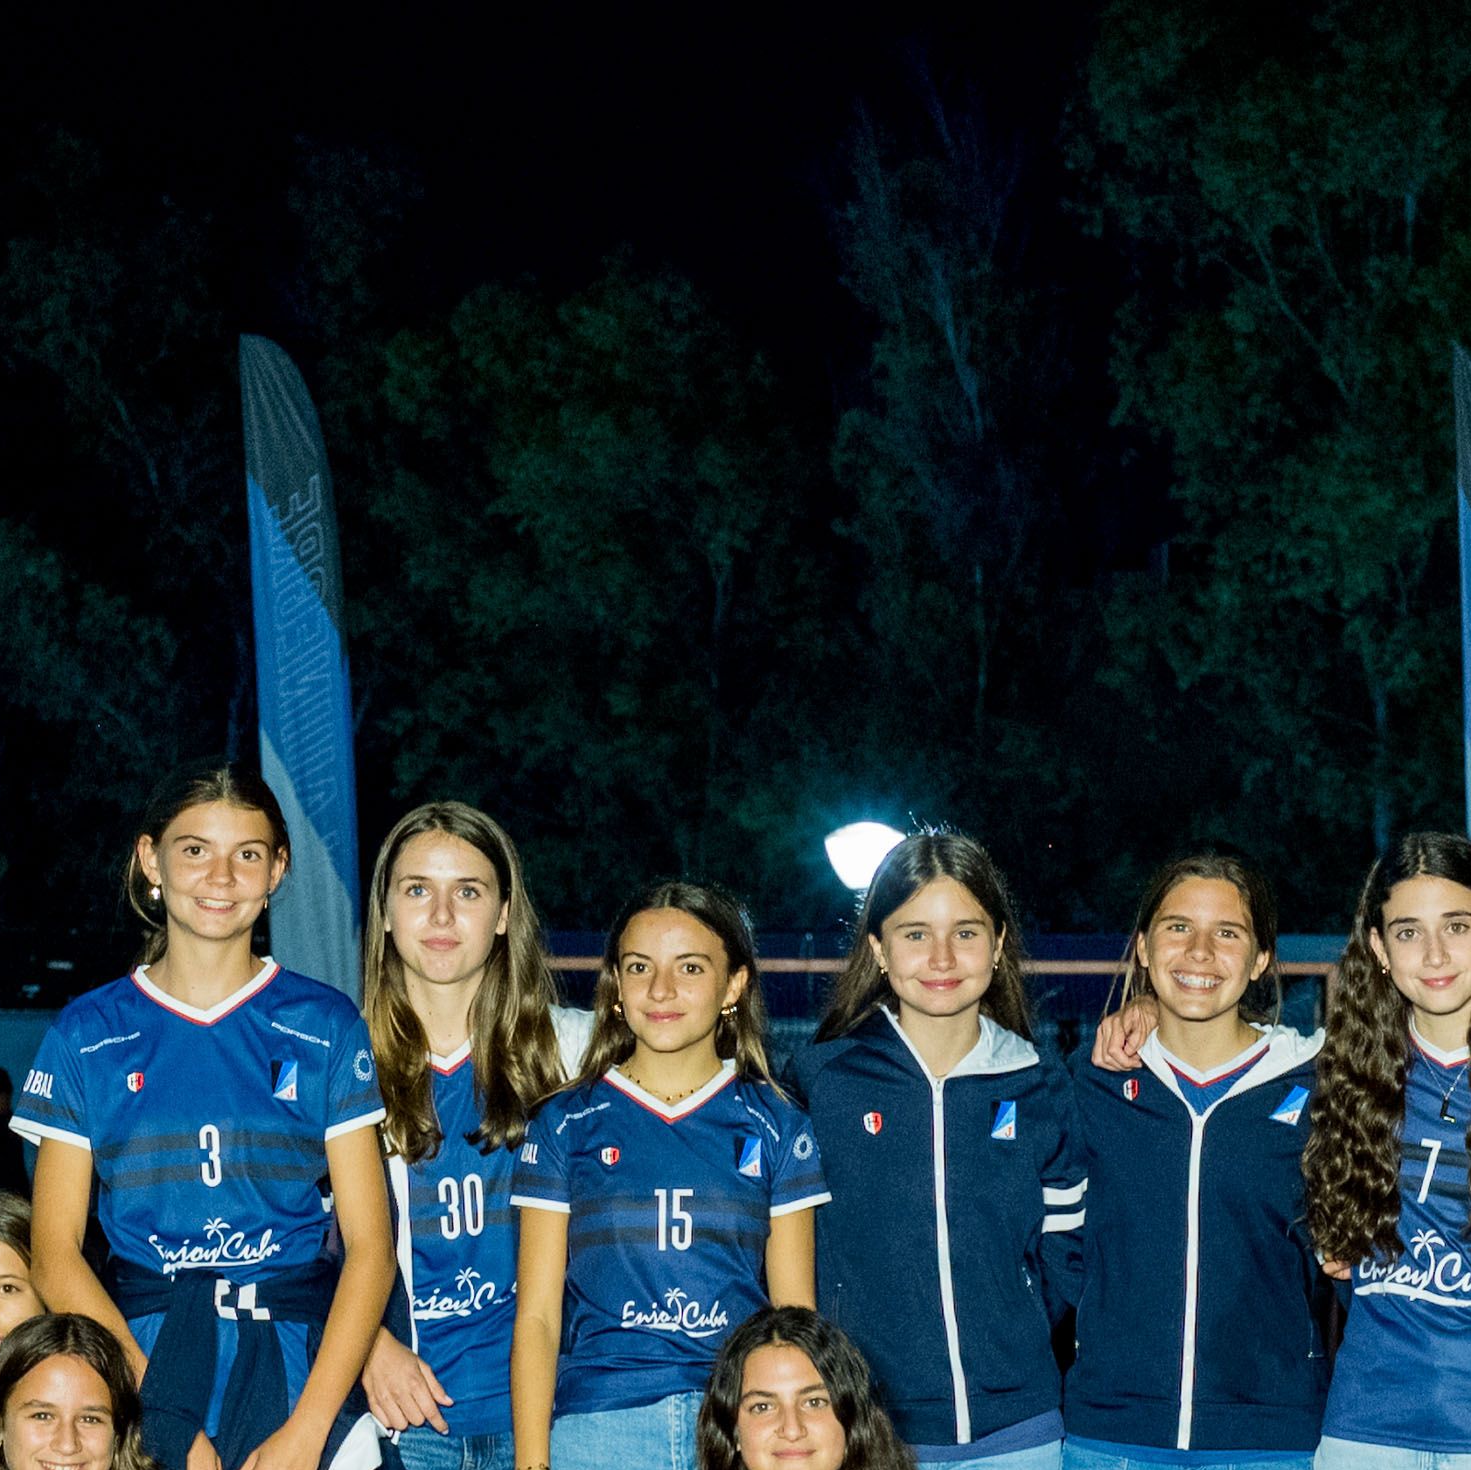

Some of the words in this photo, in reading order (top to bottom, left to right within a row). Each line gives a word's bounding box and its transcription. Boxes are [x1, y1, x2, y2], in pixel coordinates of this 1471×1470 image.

[198, 1124, 223, 1188] 3
[1417, 1138, 1442, 1204] 7
[438, 1172, 484, 1240] 30
[654, 1188, 694, 1251] 15
